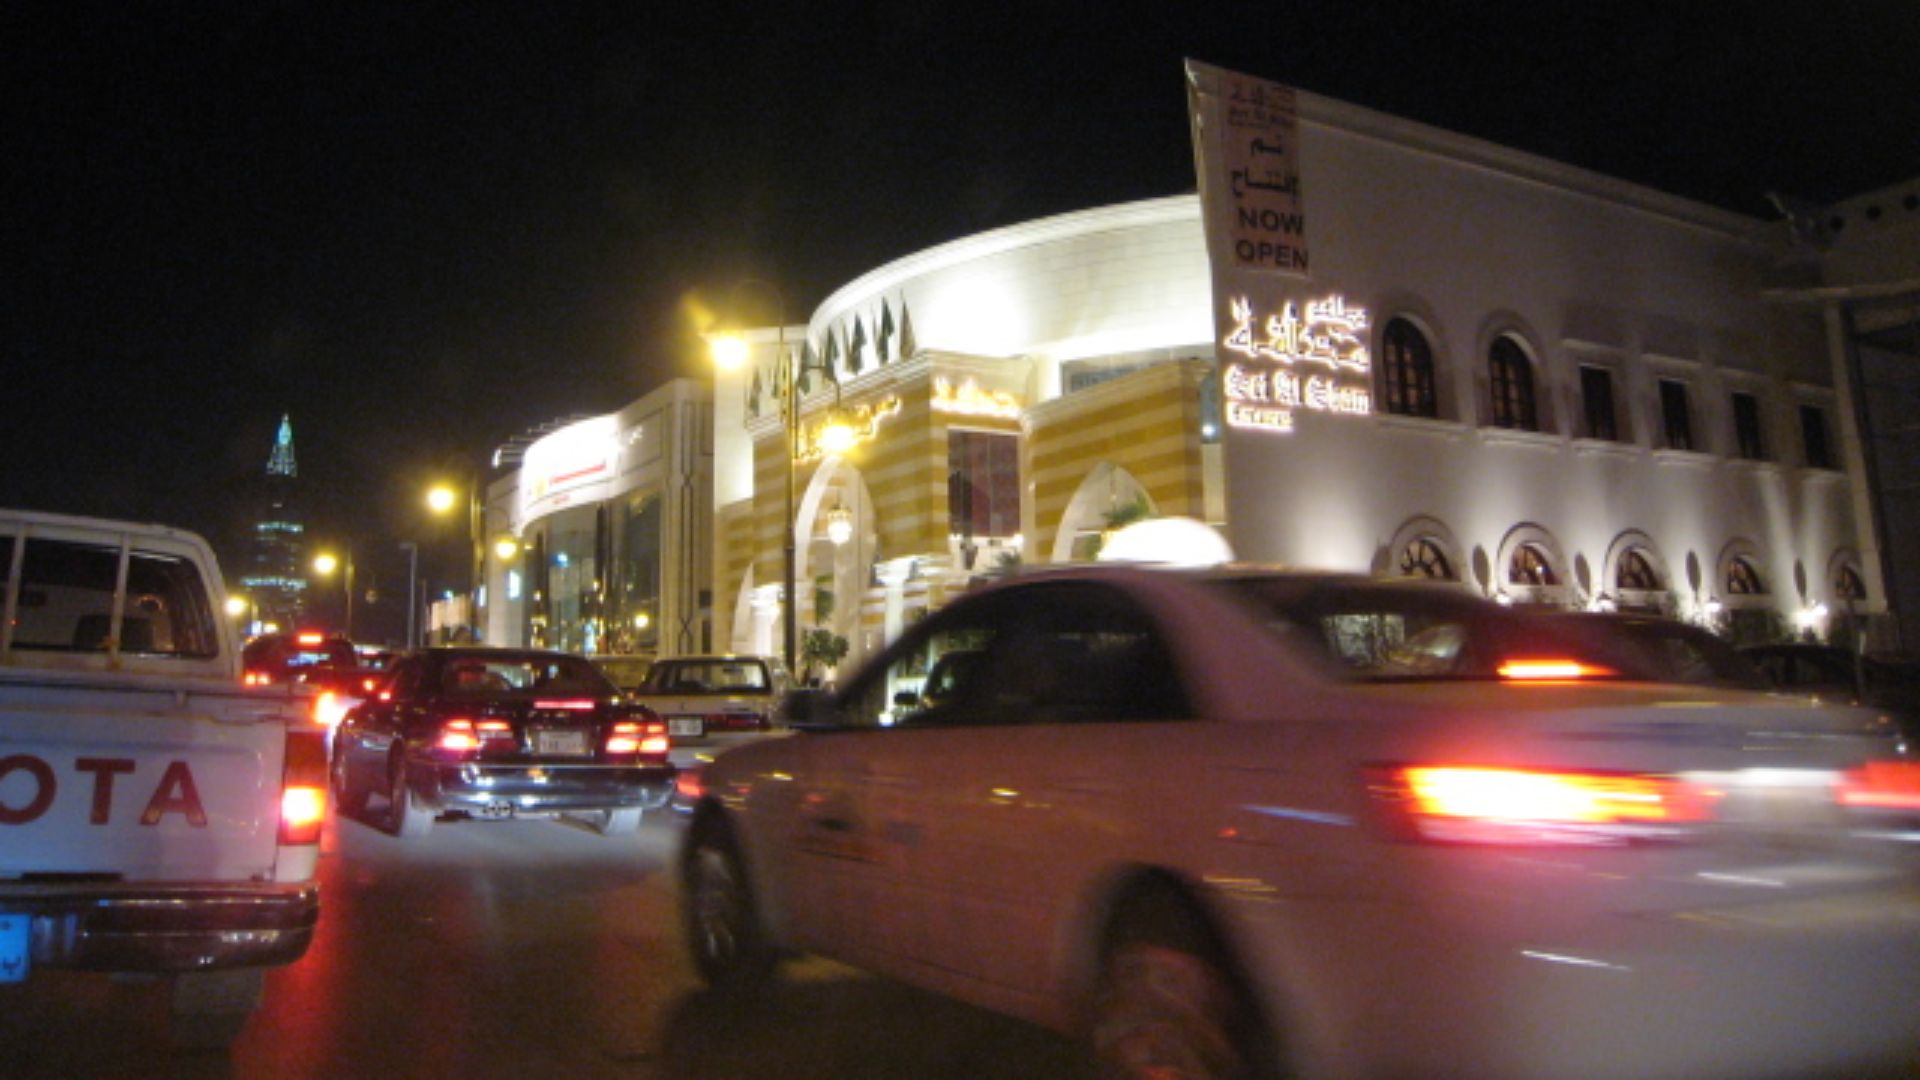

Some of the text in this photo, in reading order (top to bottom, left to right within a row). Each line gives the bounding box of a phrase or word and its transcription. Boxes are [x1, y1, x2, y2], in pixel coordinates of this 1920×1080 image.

[1238, 206, 1304, 236] NOW
[1234, 239, 1309, 270] OPEN
[0, 754, 207, 826] OTA
